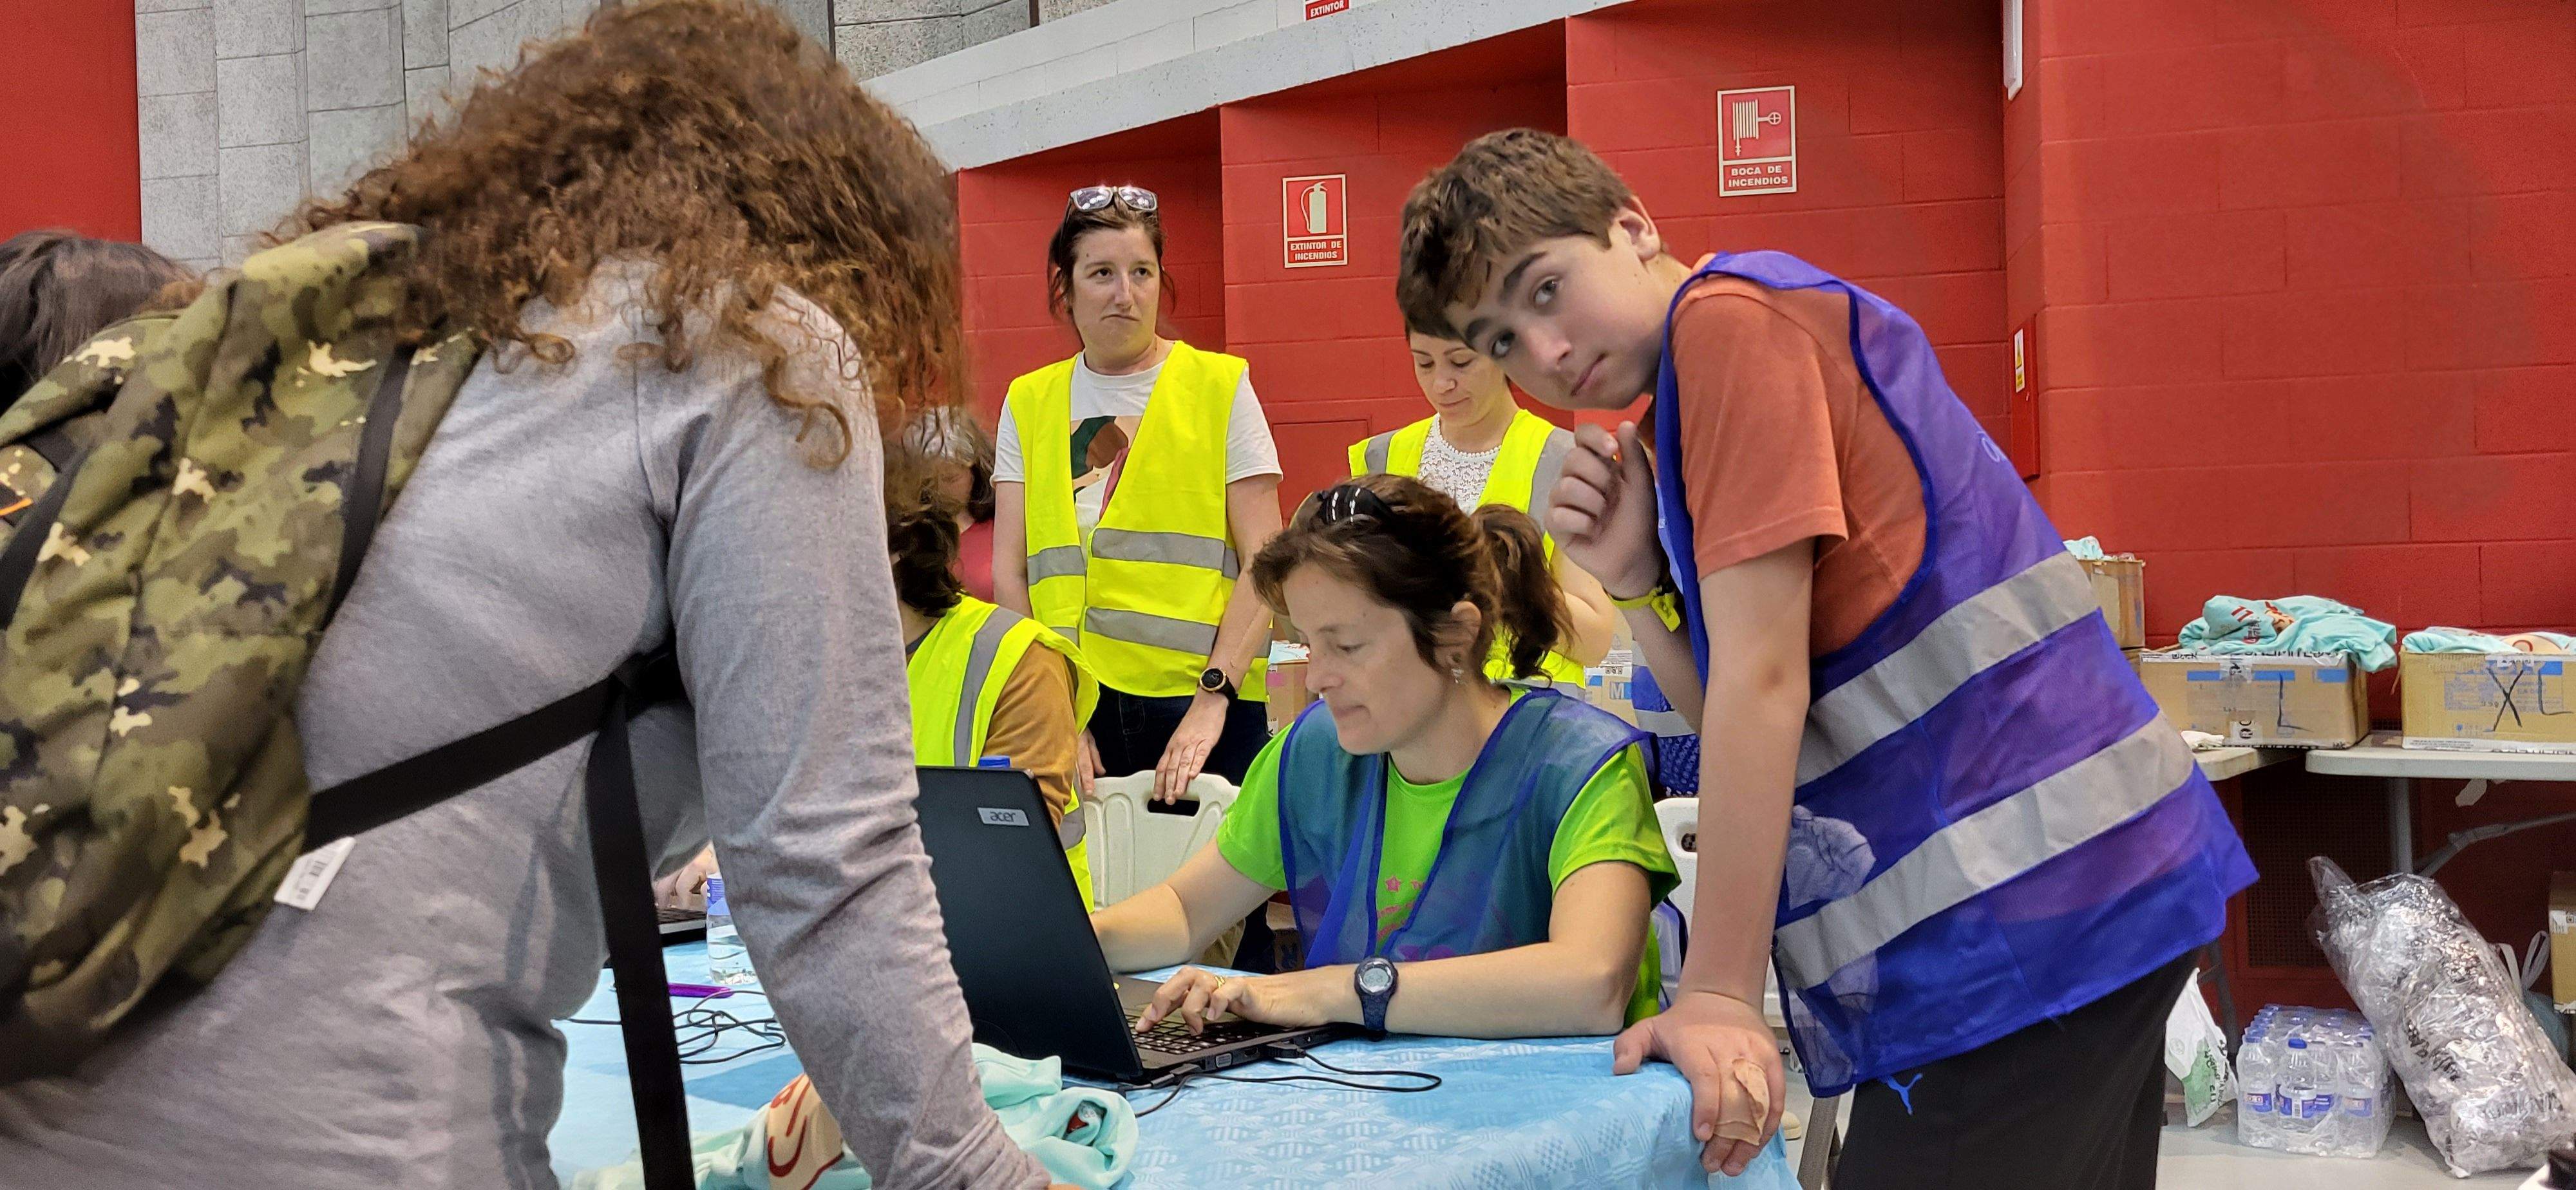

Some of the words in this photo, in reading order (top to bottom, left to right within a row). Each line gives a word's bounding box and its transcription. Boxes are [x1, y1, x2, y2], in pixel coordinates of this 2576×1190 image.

[1310, 0, 1344, 17] EXTINTOR
[1731, 167, 1761, 176] BOCA
[1767, 165, 1782, 174] DE
[1728, 176, 1788, 187] INCENDIOS
[1290, 241, 1327, 251] EXTINTOR
[1331, 240, 1342, 249] DE
[1294, 251, 1338, 261] INCENDIOS
[989, 811, 1016, 823] acer
